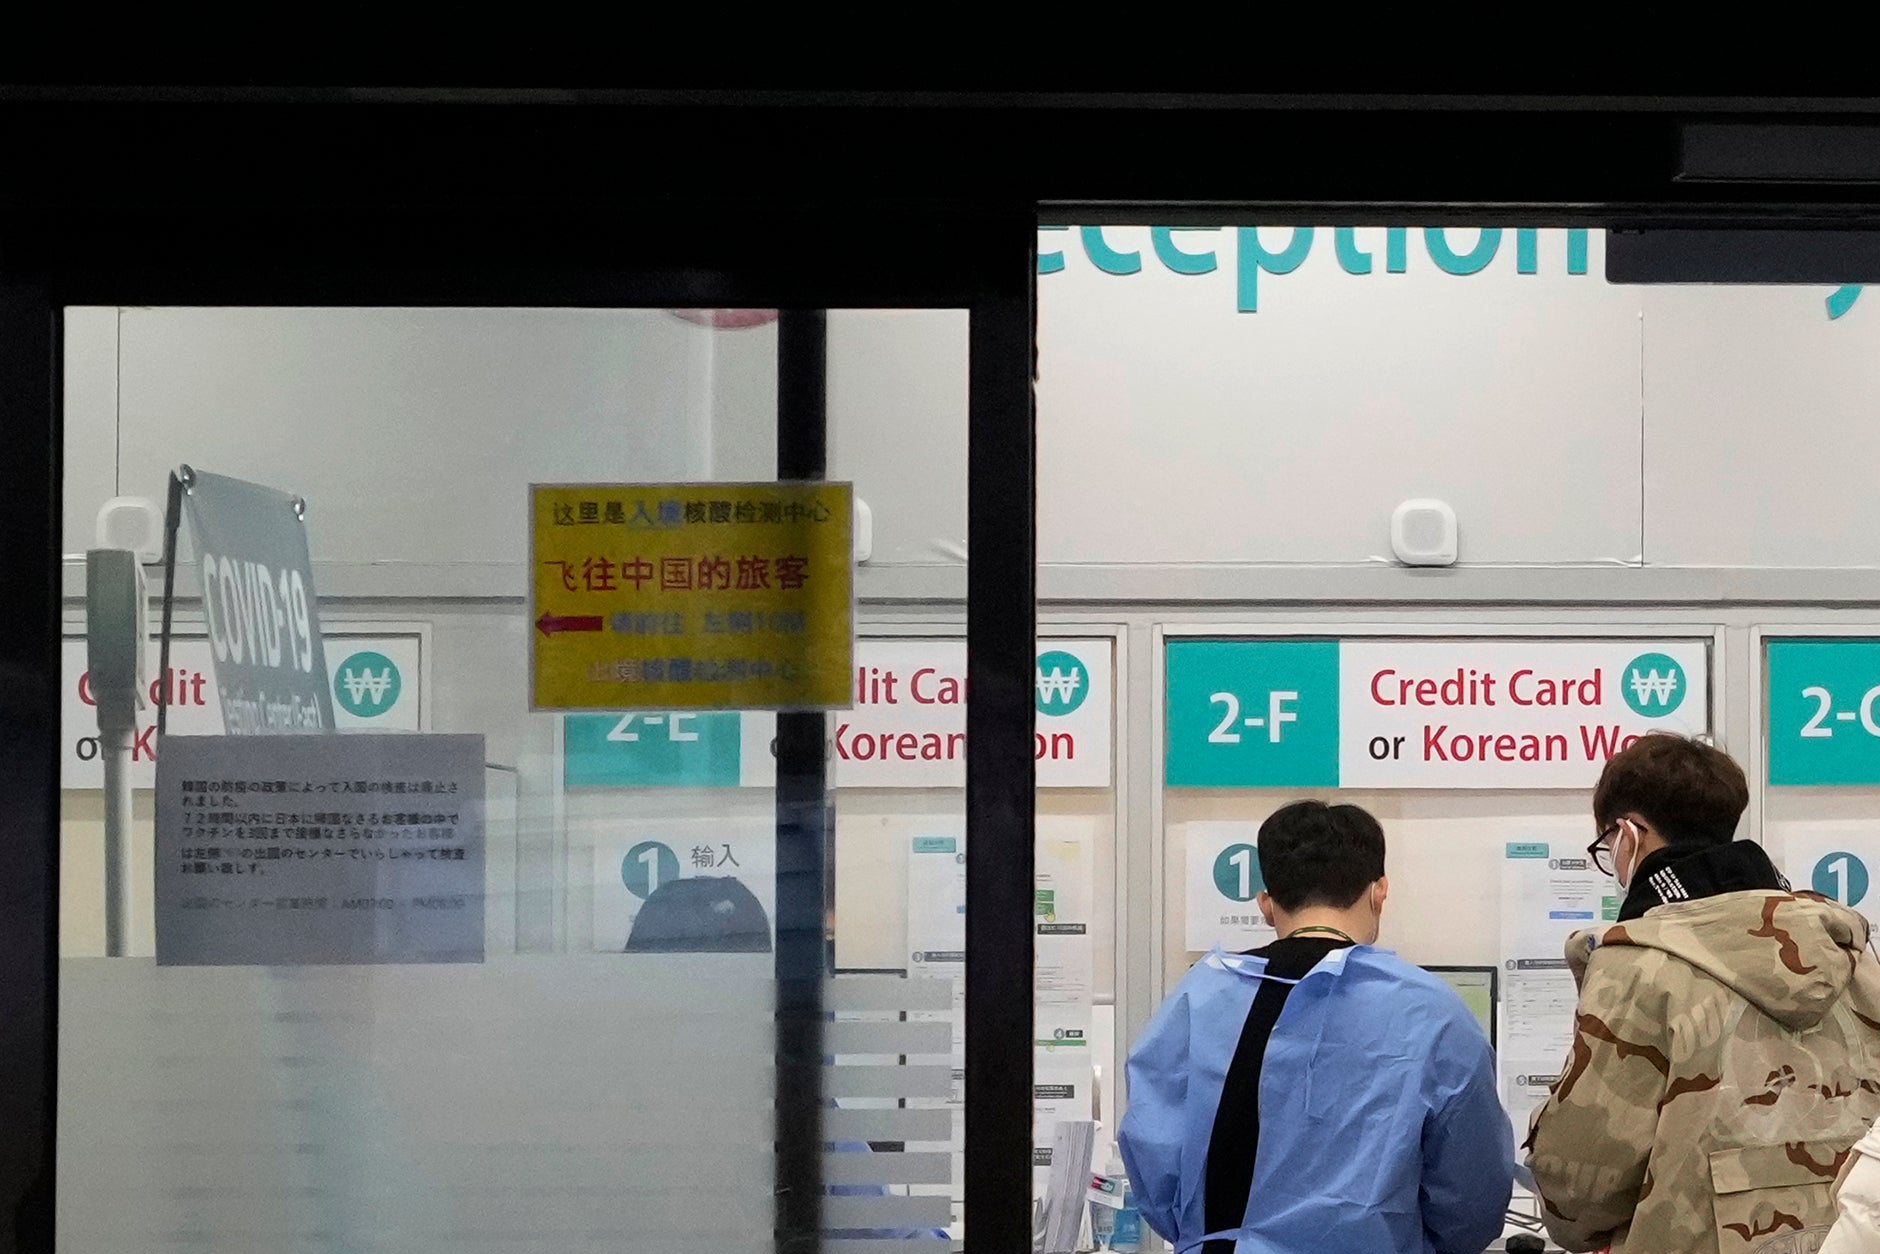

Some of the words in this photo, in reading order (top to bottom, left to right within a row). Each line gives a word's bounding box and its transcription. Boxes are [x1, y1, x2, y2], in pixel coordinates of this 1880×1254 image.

[543, 555, 810, 592] 飞往中国的旅客
[203, 553, 312, 672] COVID-19
[1370, 668, 1496, 706] Credit
[1508, 668, 1602, 706] Card
[1207, 691, 1299, 745] 2-F
[1369, 733, 1405, 761] or
[1422, 726, 1568, 762] Korean
[691, 844, 740, 868] 输入
